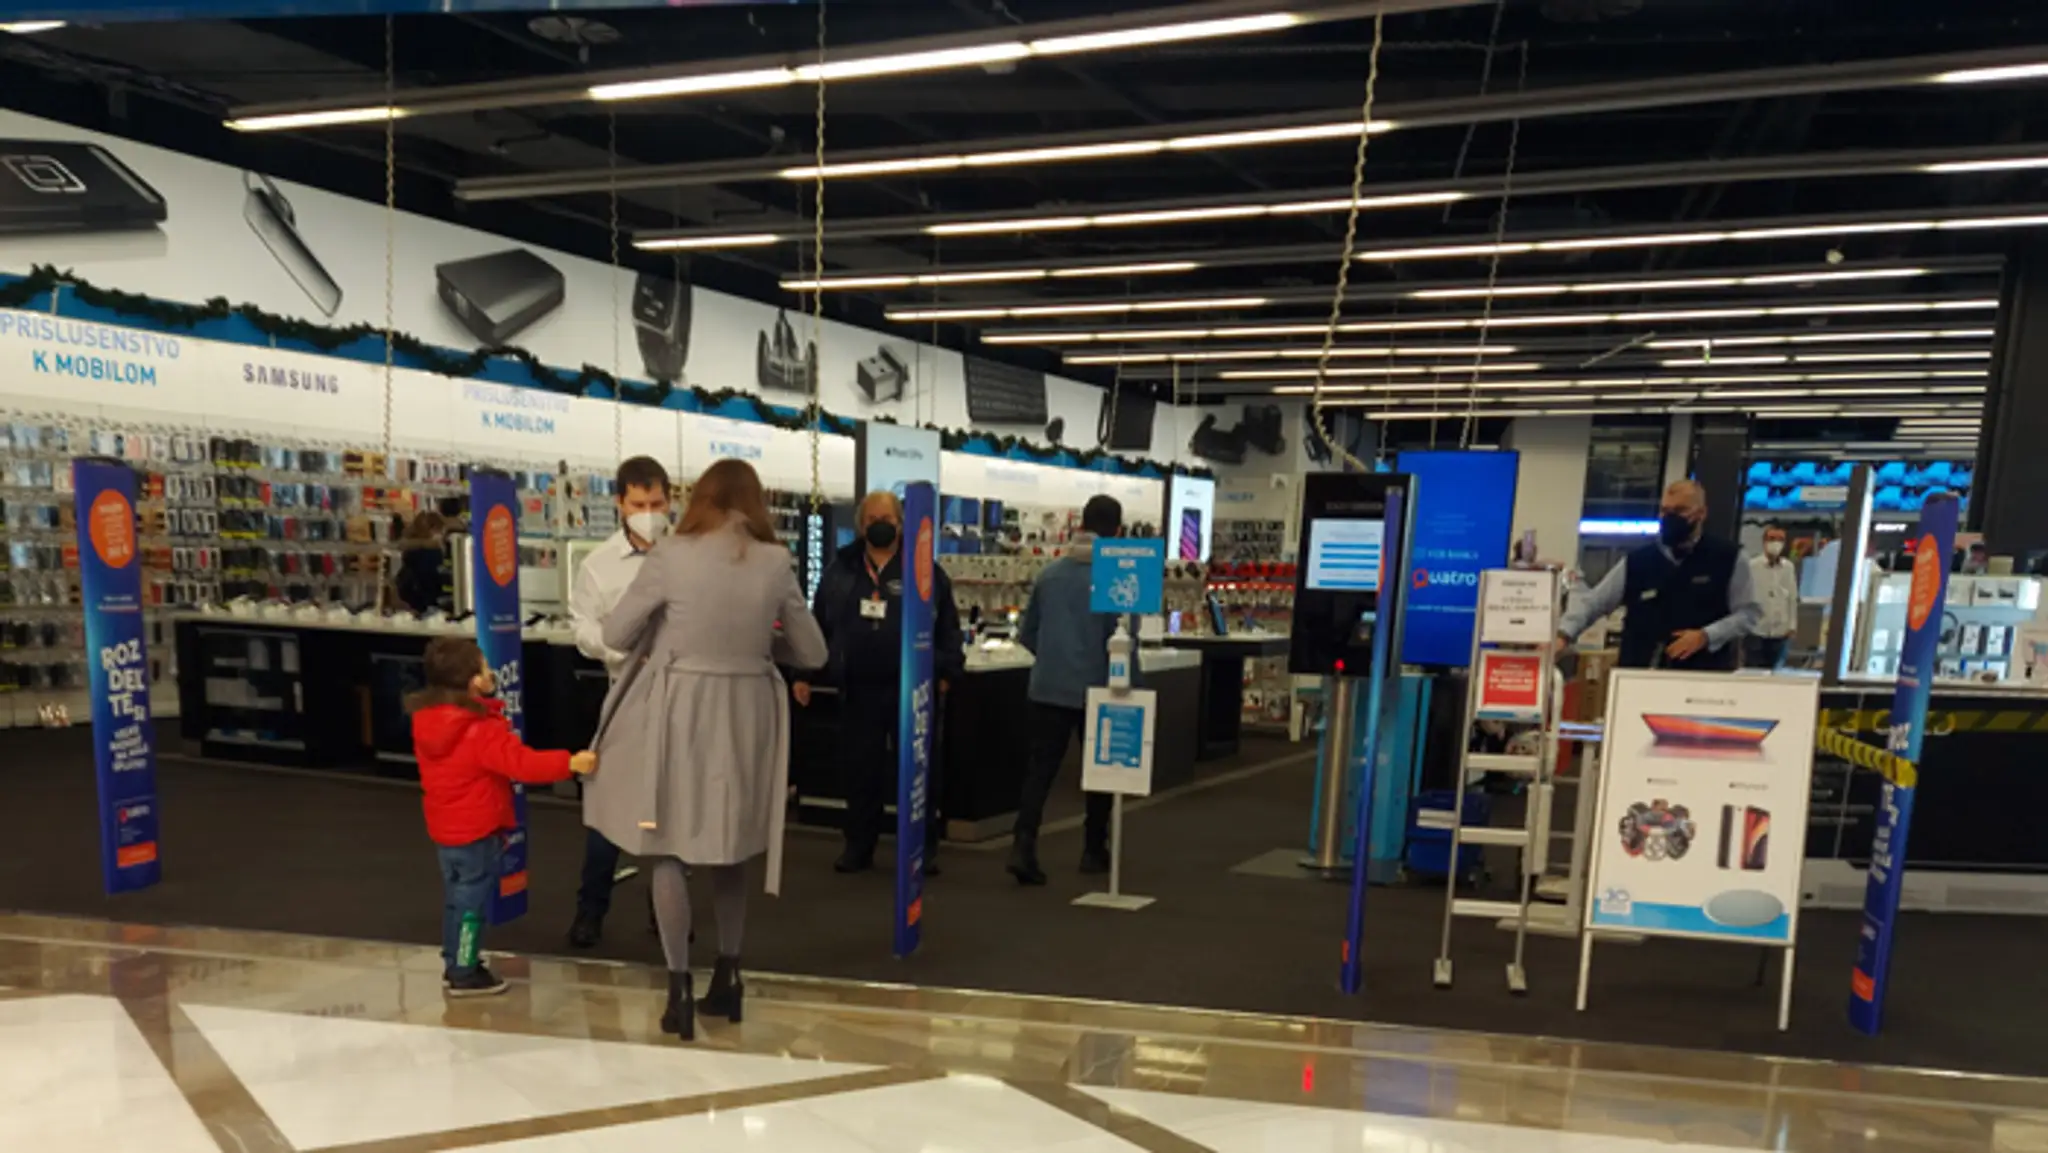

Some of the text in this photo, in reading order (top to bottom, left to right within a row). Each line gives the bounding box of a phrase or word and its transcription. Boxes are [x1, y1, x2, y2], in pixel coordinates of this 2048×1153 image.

[32, 350, 156, 386] K MOBILOM
[243, 363, 339, 394] SAMSUNG
[481, 411, 554, 434] K MOBILOM
[101, 638, 141, 670] ROZ
